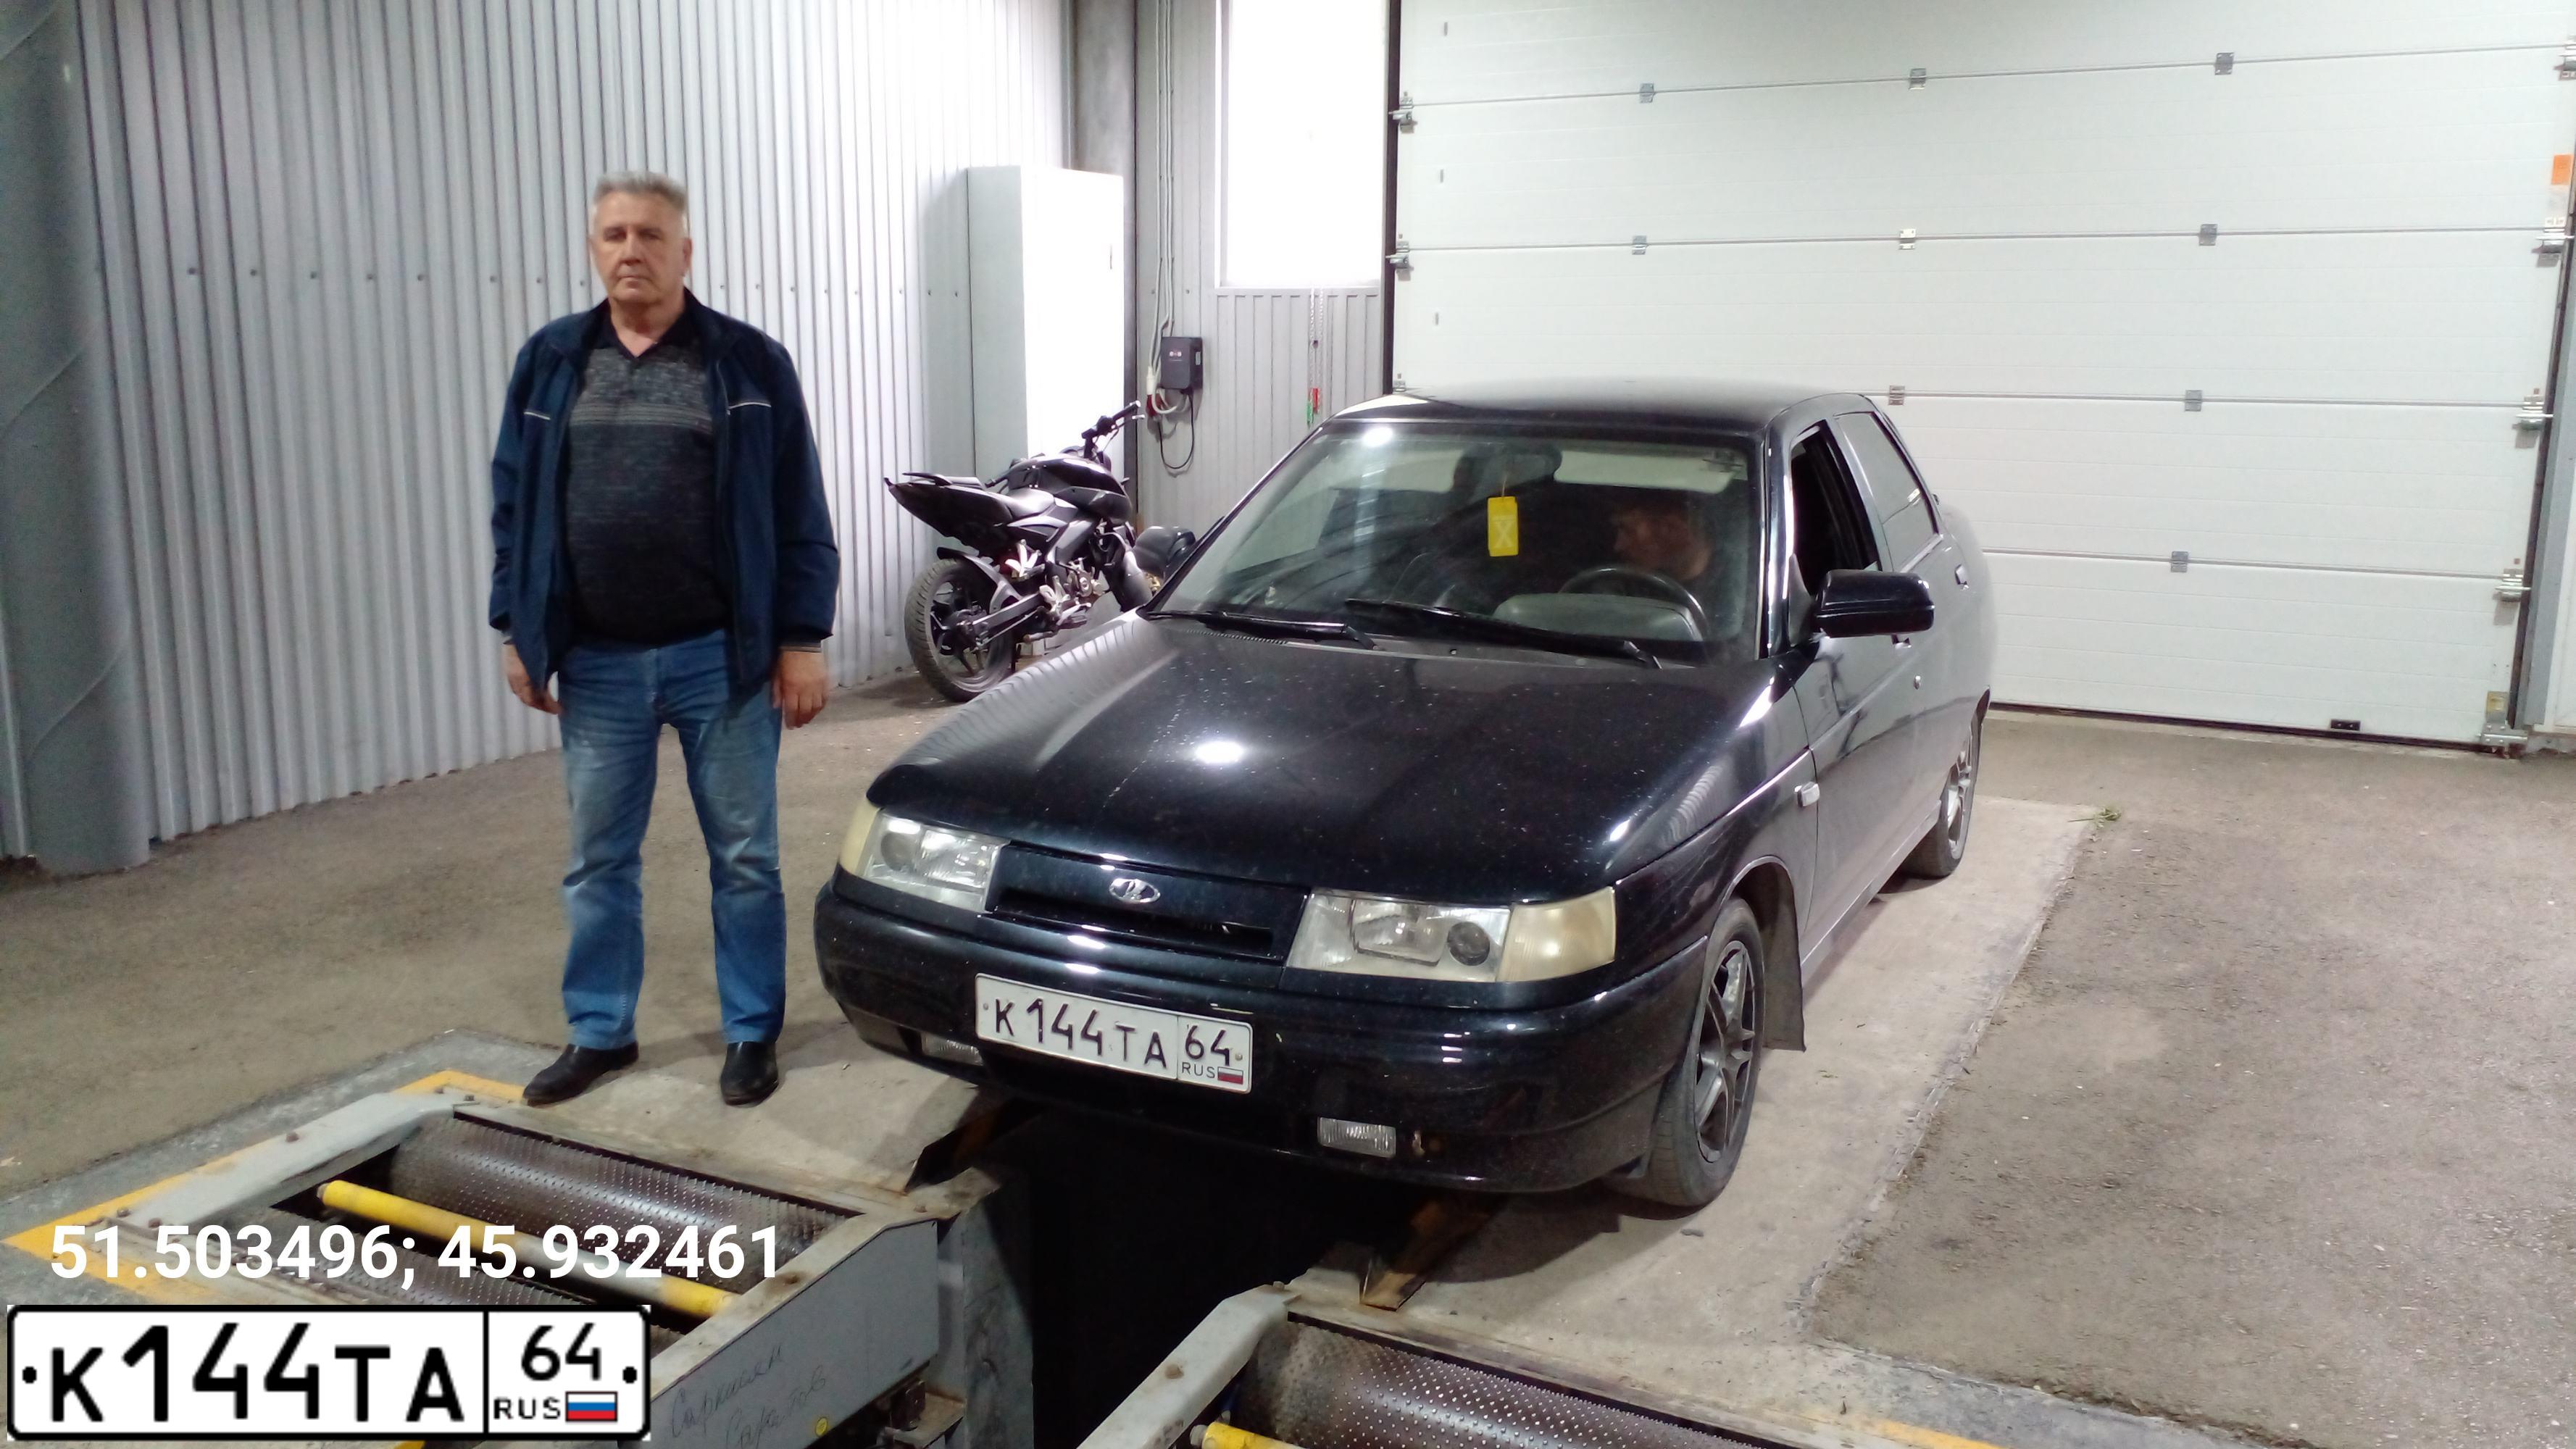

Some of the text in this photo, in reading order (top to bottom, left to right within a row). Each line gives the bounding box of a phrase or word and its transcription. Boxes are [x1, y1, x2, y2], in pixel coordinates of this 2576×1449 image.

[994, 998, 1230, 1069] К144ТА 64
[1181, 1061, 1216, 1080] RUS
